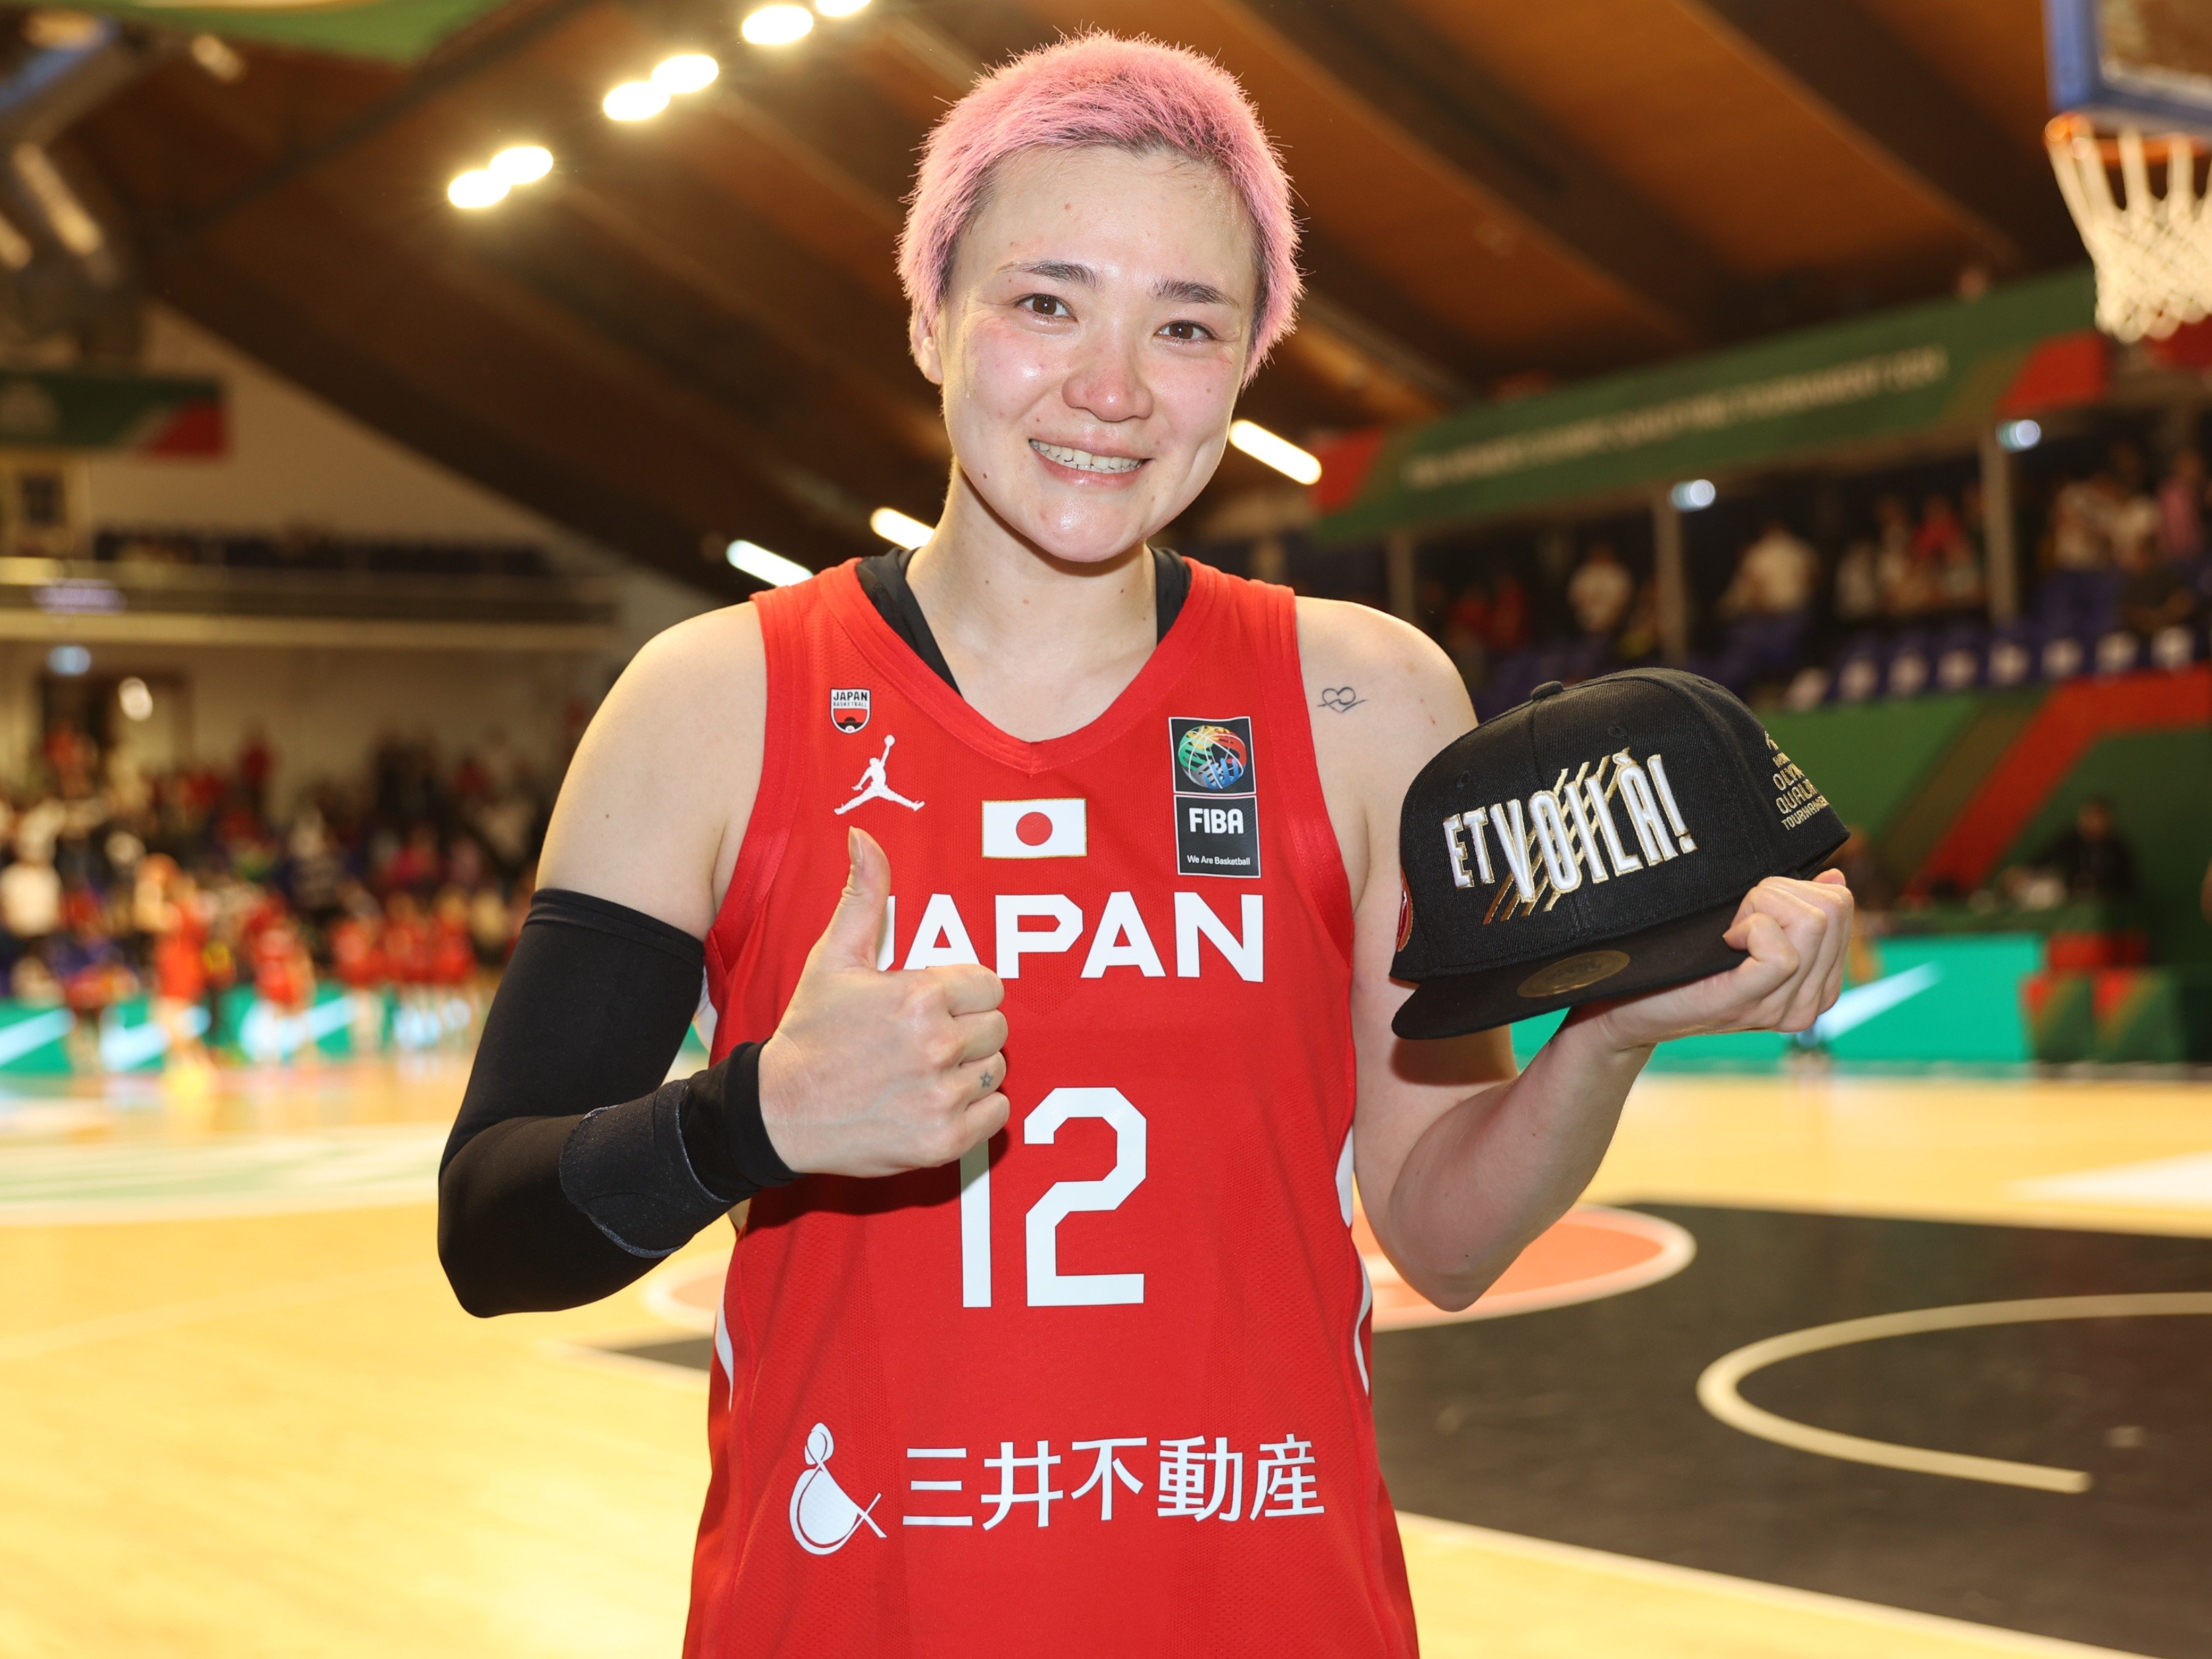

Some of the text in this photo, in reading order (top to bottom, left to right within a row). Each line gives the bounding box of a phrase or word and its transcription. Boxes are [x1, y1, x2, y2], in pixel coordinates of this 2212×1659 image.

[833, 692, 868, 701] JAPAN
[1189, 807, 1245, 834] FIBA
[1443, 806, 1495, 889] ET
[1186, 854, 1251, 865] We Are Basketball
[960, 1087, 1147, 1308] 12
[902, 1433, 1325, 1531] 三井不動産
